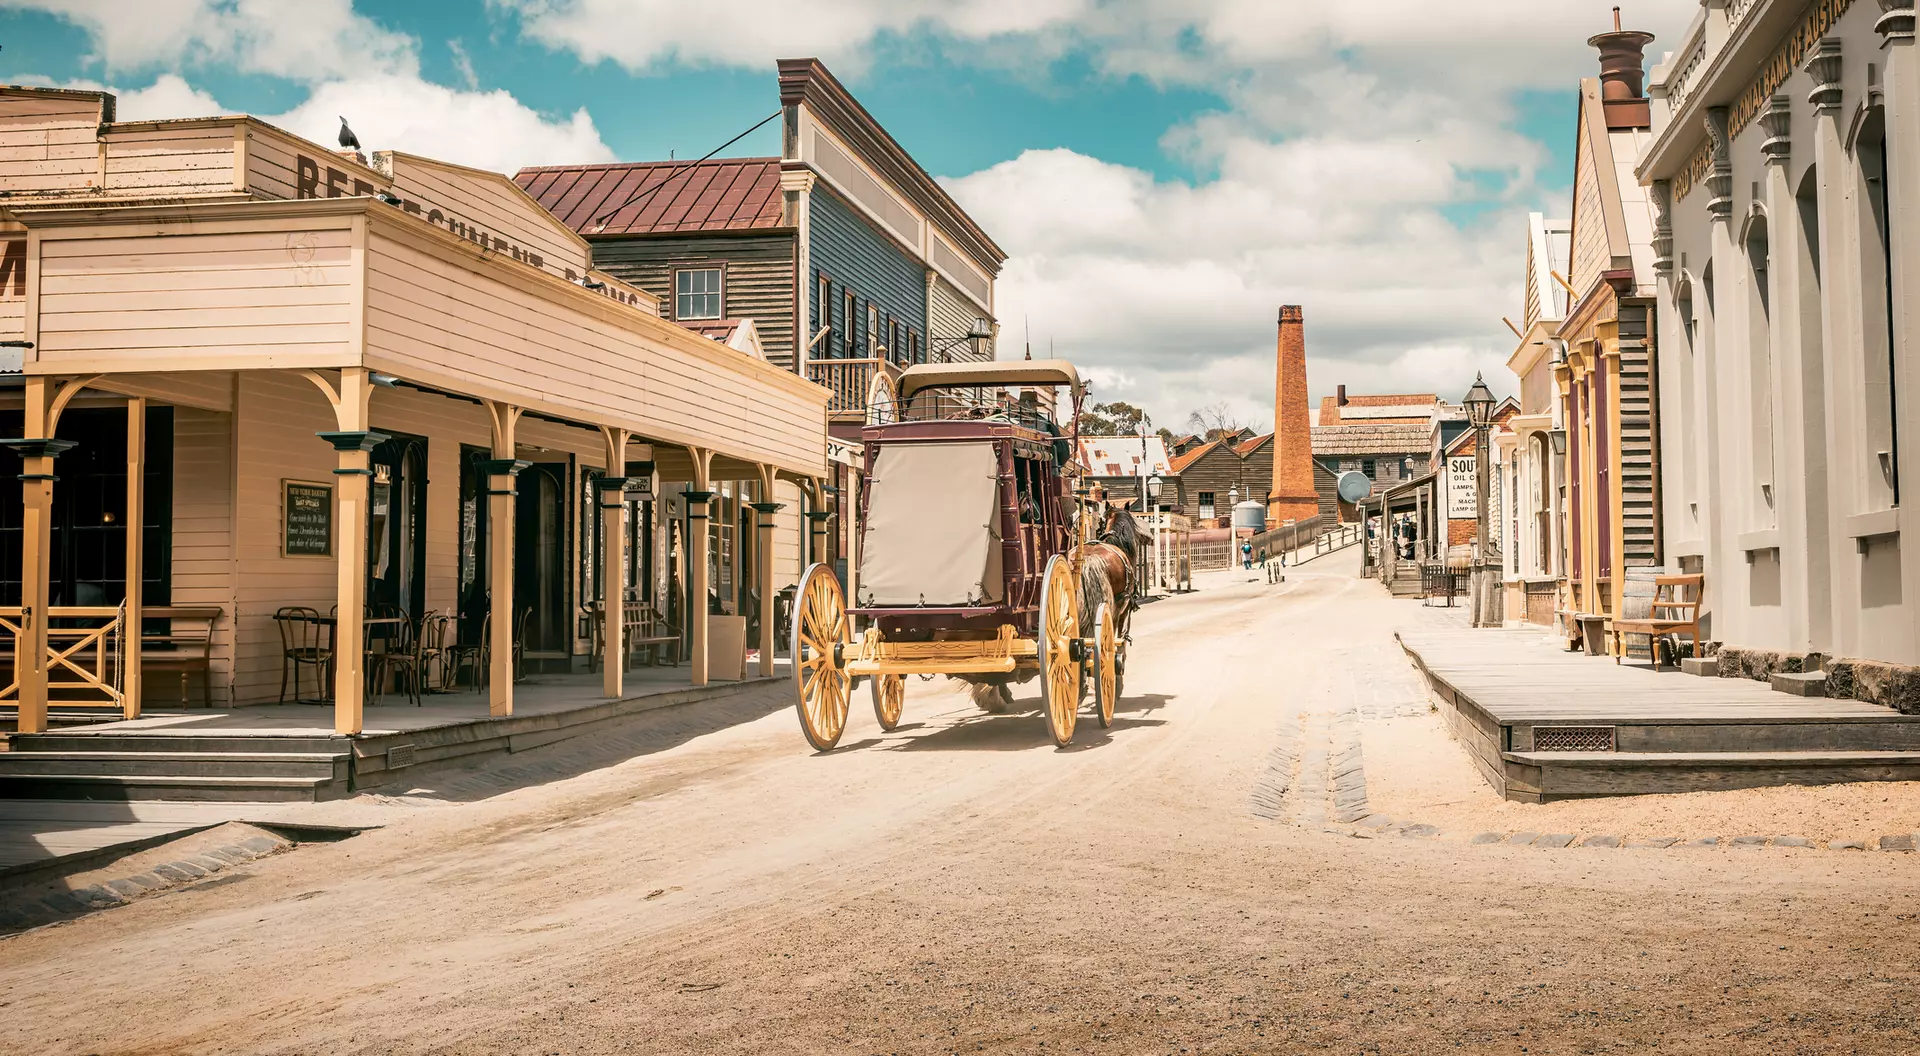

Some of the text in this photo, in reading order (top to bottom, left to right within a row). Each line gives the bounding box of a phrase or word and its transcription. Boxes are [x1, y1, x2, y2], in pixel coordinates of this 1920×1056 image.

[1727, 79, 1765, 142] COLONIAL
[1764, 43, 1792, 99] BANK
[1790, 27, 1804, 68] OF
[1674, 169, 1691, 204] GOLD
